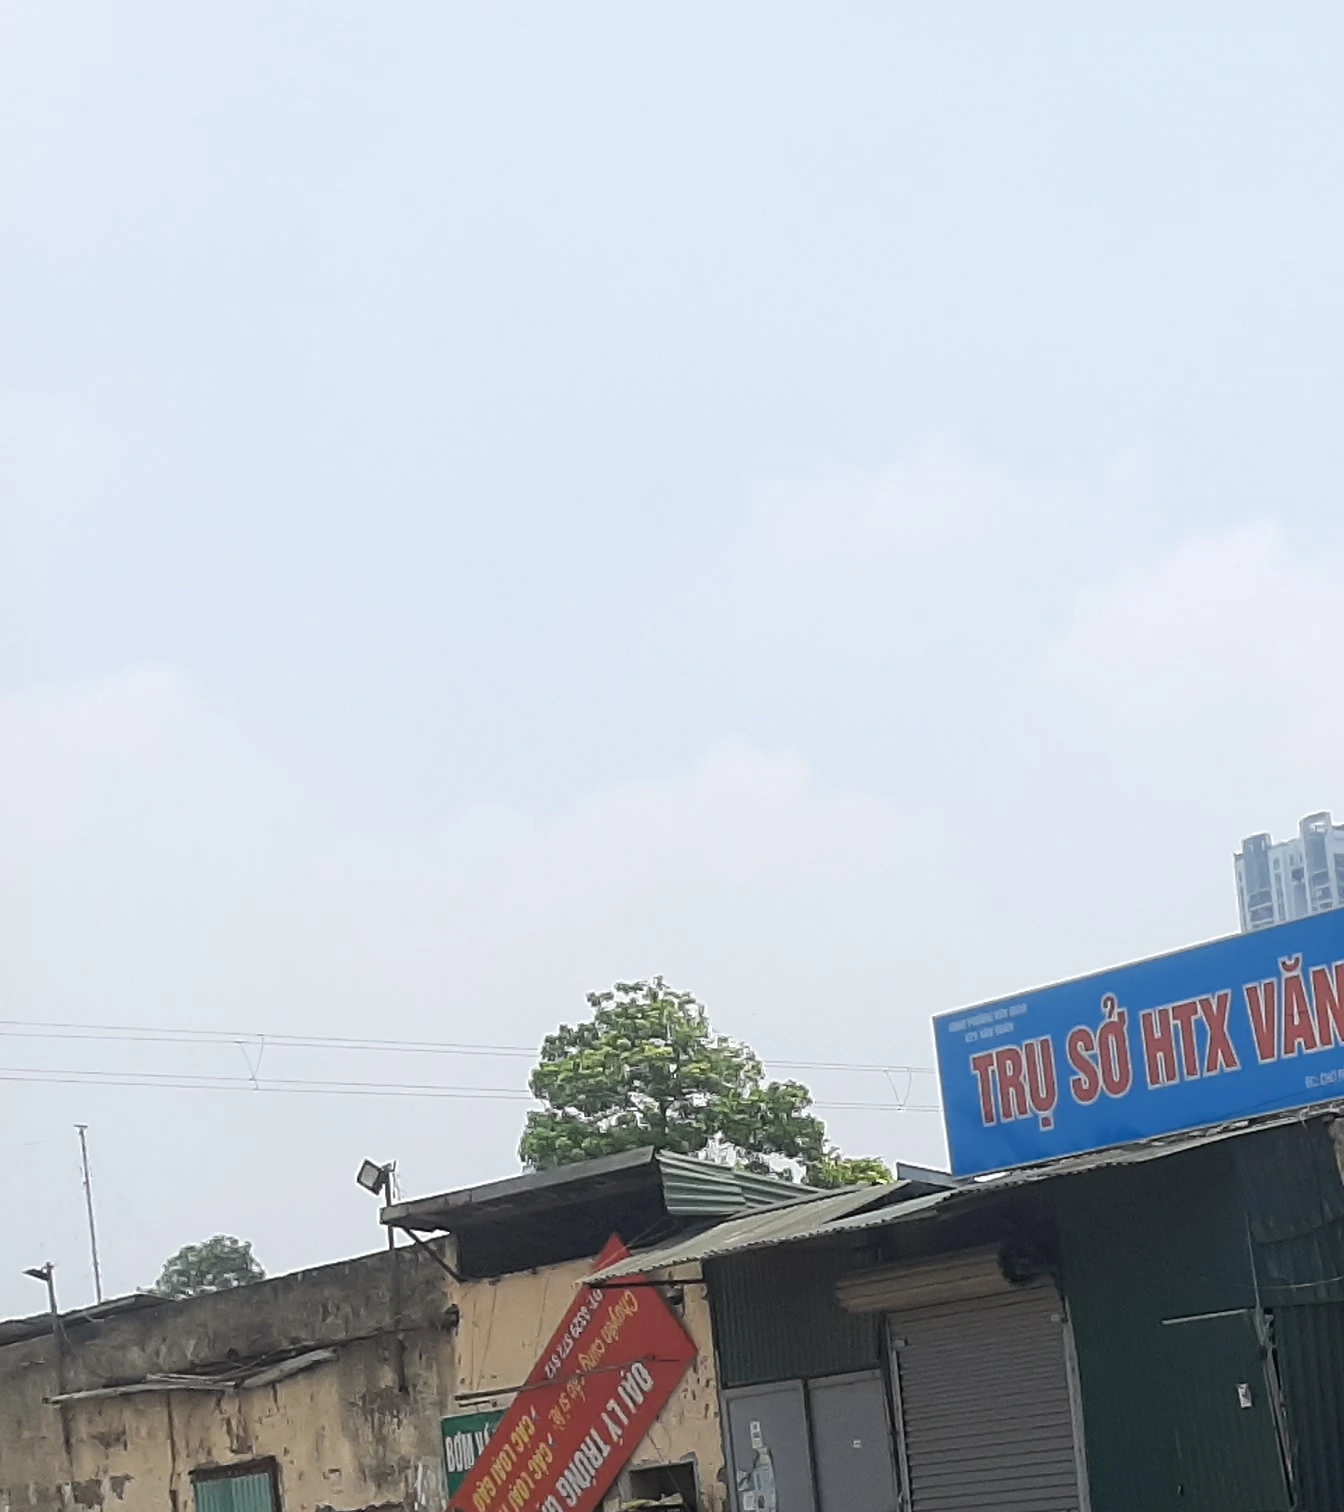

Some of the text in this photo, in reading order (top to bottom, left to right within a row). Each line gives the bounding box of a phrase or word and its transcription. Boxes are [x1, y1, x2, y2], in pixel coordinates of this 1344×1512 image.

[969, 1036, 1058, 1131] TRỤ
[1065, 991, 1134, 1107] SỞ
[1138, 988, 1240, 1091] HTX
[618, 1362, 653, 1413] ĐẠI
[601, 1399, 628, 1444] LÝ
[445, 1430, 475, 1472] BƠM
[473, 1414, 536, 1512] CÁC LOẠI GẠO
[525, 1440, 553, 1479] CÁC
[556, 1426, 610, 1506] TRỨNG
[508, 1472, 534, 1512] LOẠI
